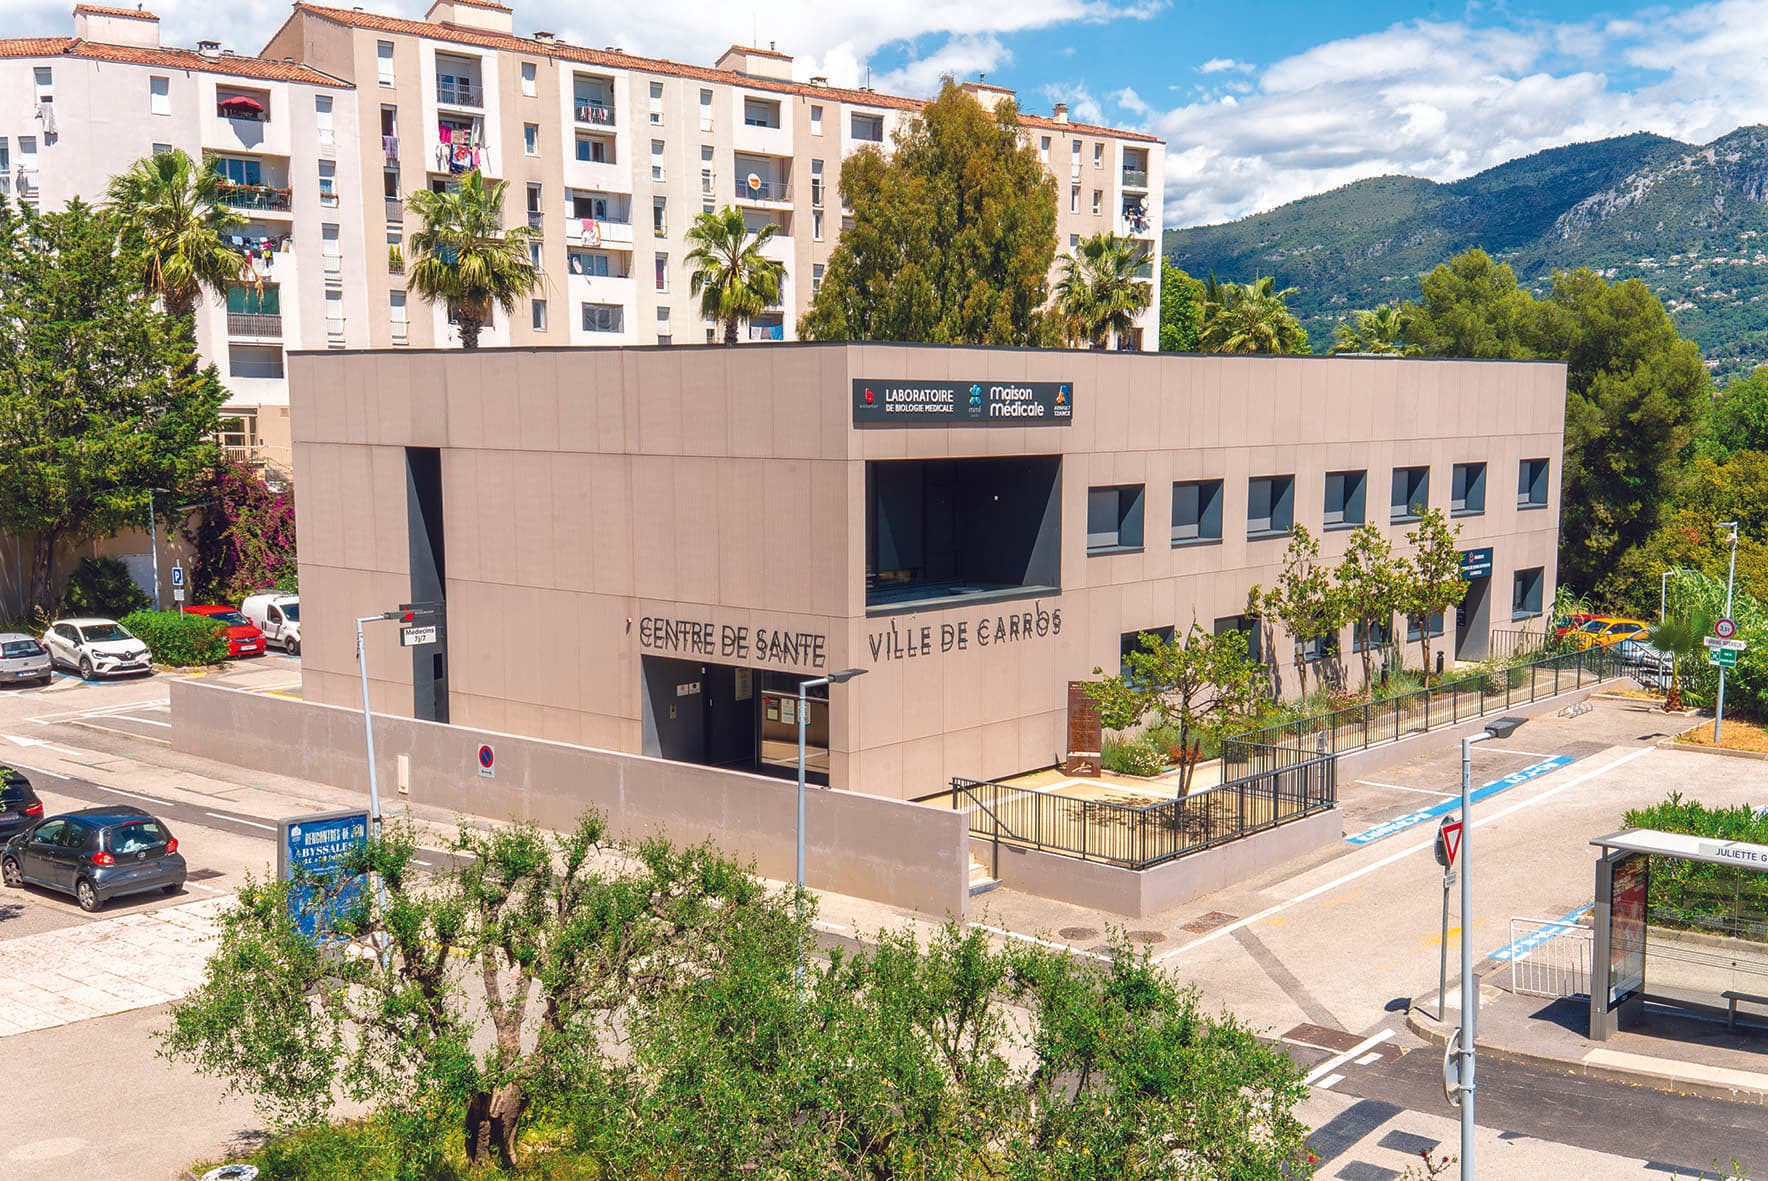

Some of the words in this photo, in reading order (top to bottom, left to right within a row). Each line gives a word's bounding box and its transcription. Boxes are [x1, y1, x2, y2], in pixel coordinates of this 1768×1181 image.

[885, 389, 954, 402] LABORATOIRE
[886, 404, 895, 412] DE
[895, 404, 924, 412] BIOLOGIE
[869, 627, 932, 662] VILLE
[941, 621, 968, 653] DE
[977, 608, 1062, 646] CARROS
[639, 617, 715, 654] CENTRE
[722, 625, 749, 658] DE
[756, 629, 826, 667] SANTE
[1716, 848, 1757, 860] JULIETTE
